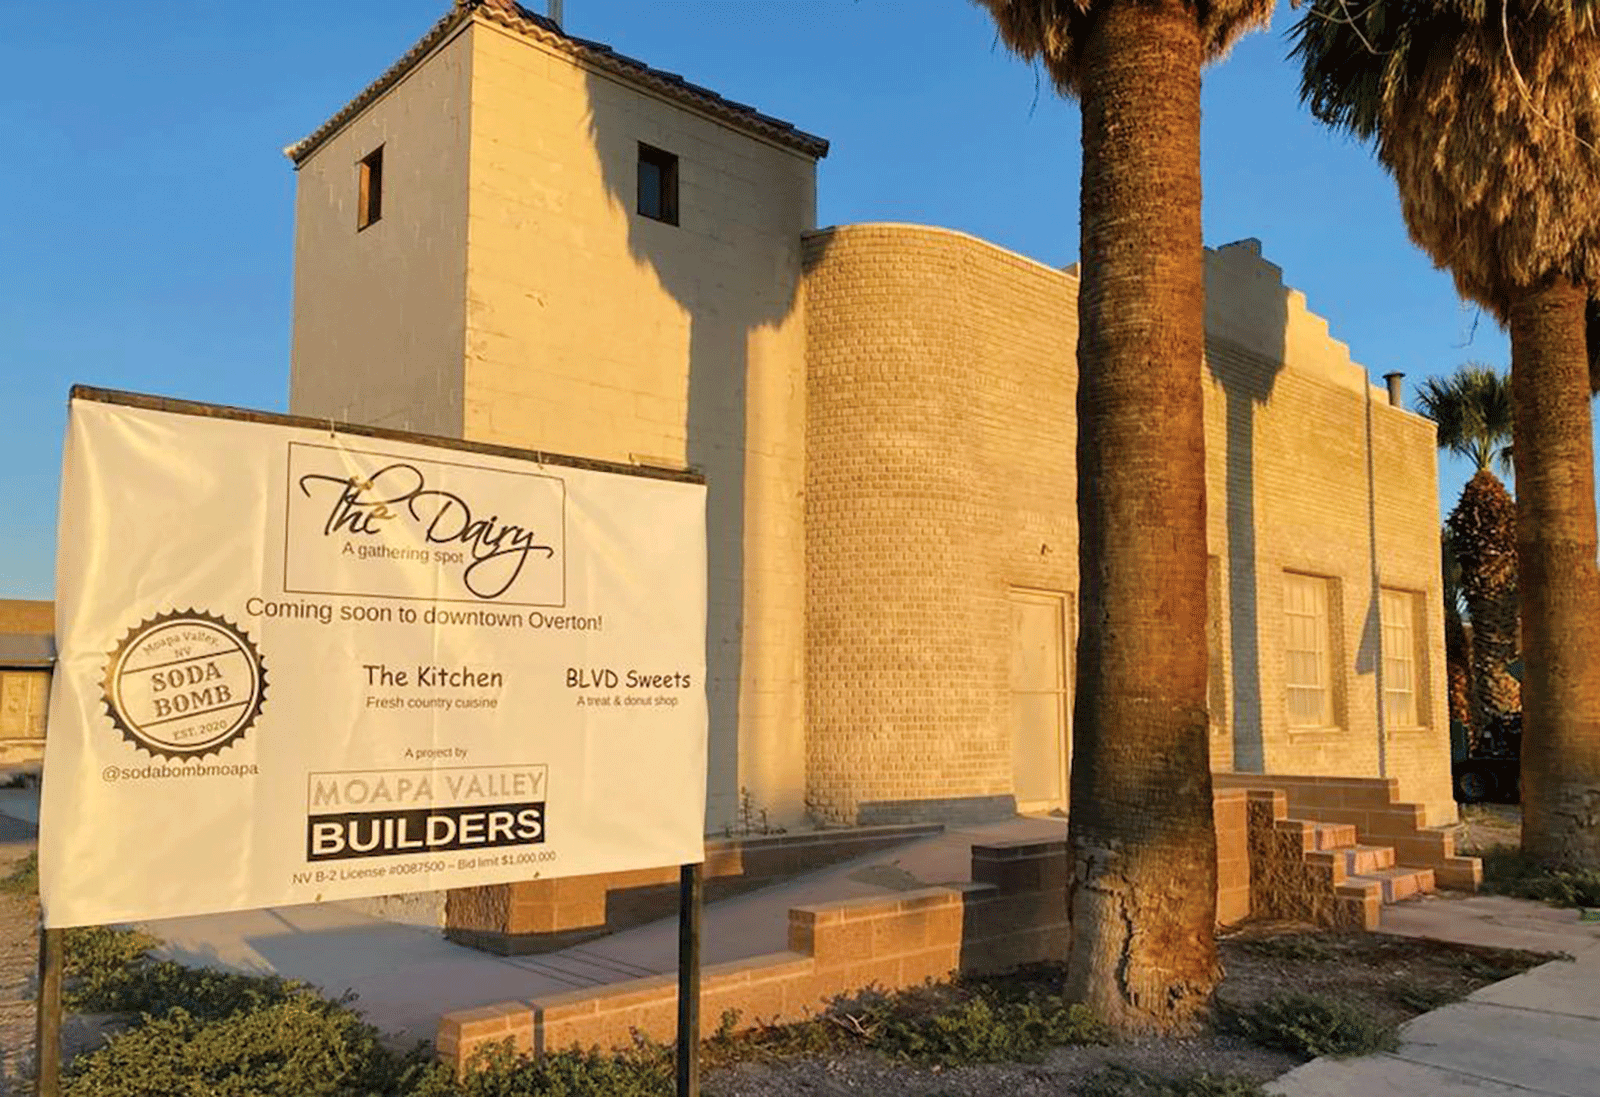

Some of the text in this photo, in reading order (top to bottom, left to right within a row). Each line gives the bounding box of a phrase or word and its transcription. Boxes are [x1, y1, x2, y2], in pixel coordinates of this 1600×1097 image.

[300, 464, 554, 599] The Dairy
[342, 542, 464, 565] A gathering spot
[246, 597, 602, 631] Coming soon to downtown Overton!
[142, 634, 181, 656] Moapa
[174, 646, 192, 658] NV
[151, 661, 223, 693] SODA
[362, 664, 503, 689] The Kitchen
[565, 667, 691, 689] BLVD Sweets
[152, 684, 232, 718] BOMB
[366, 696, 498, 711] Fresh country cuisine
[576, 695, 678, 708] A treat & donut shop
[172, 719, 228, 741] EST. 2020
[404, 747, 468, 761] A project by
[102, 763, 260, 783] @sodabombmoapa
[313, 771, 544, 807] MOAPA VALLEY
[312, 809, 542, 856] BUILDERS
[292, 872, 313, 884] NV
[315, 870, 337, 882] B-2
[340, 866, 387, 880] License
[458, 858, 477, 870] Bid
[477, 856, 499, 868] limit
